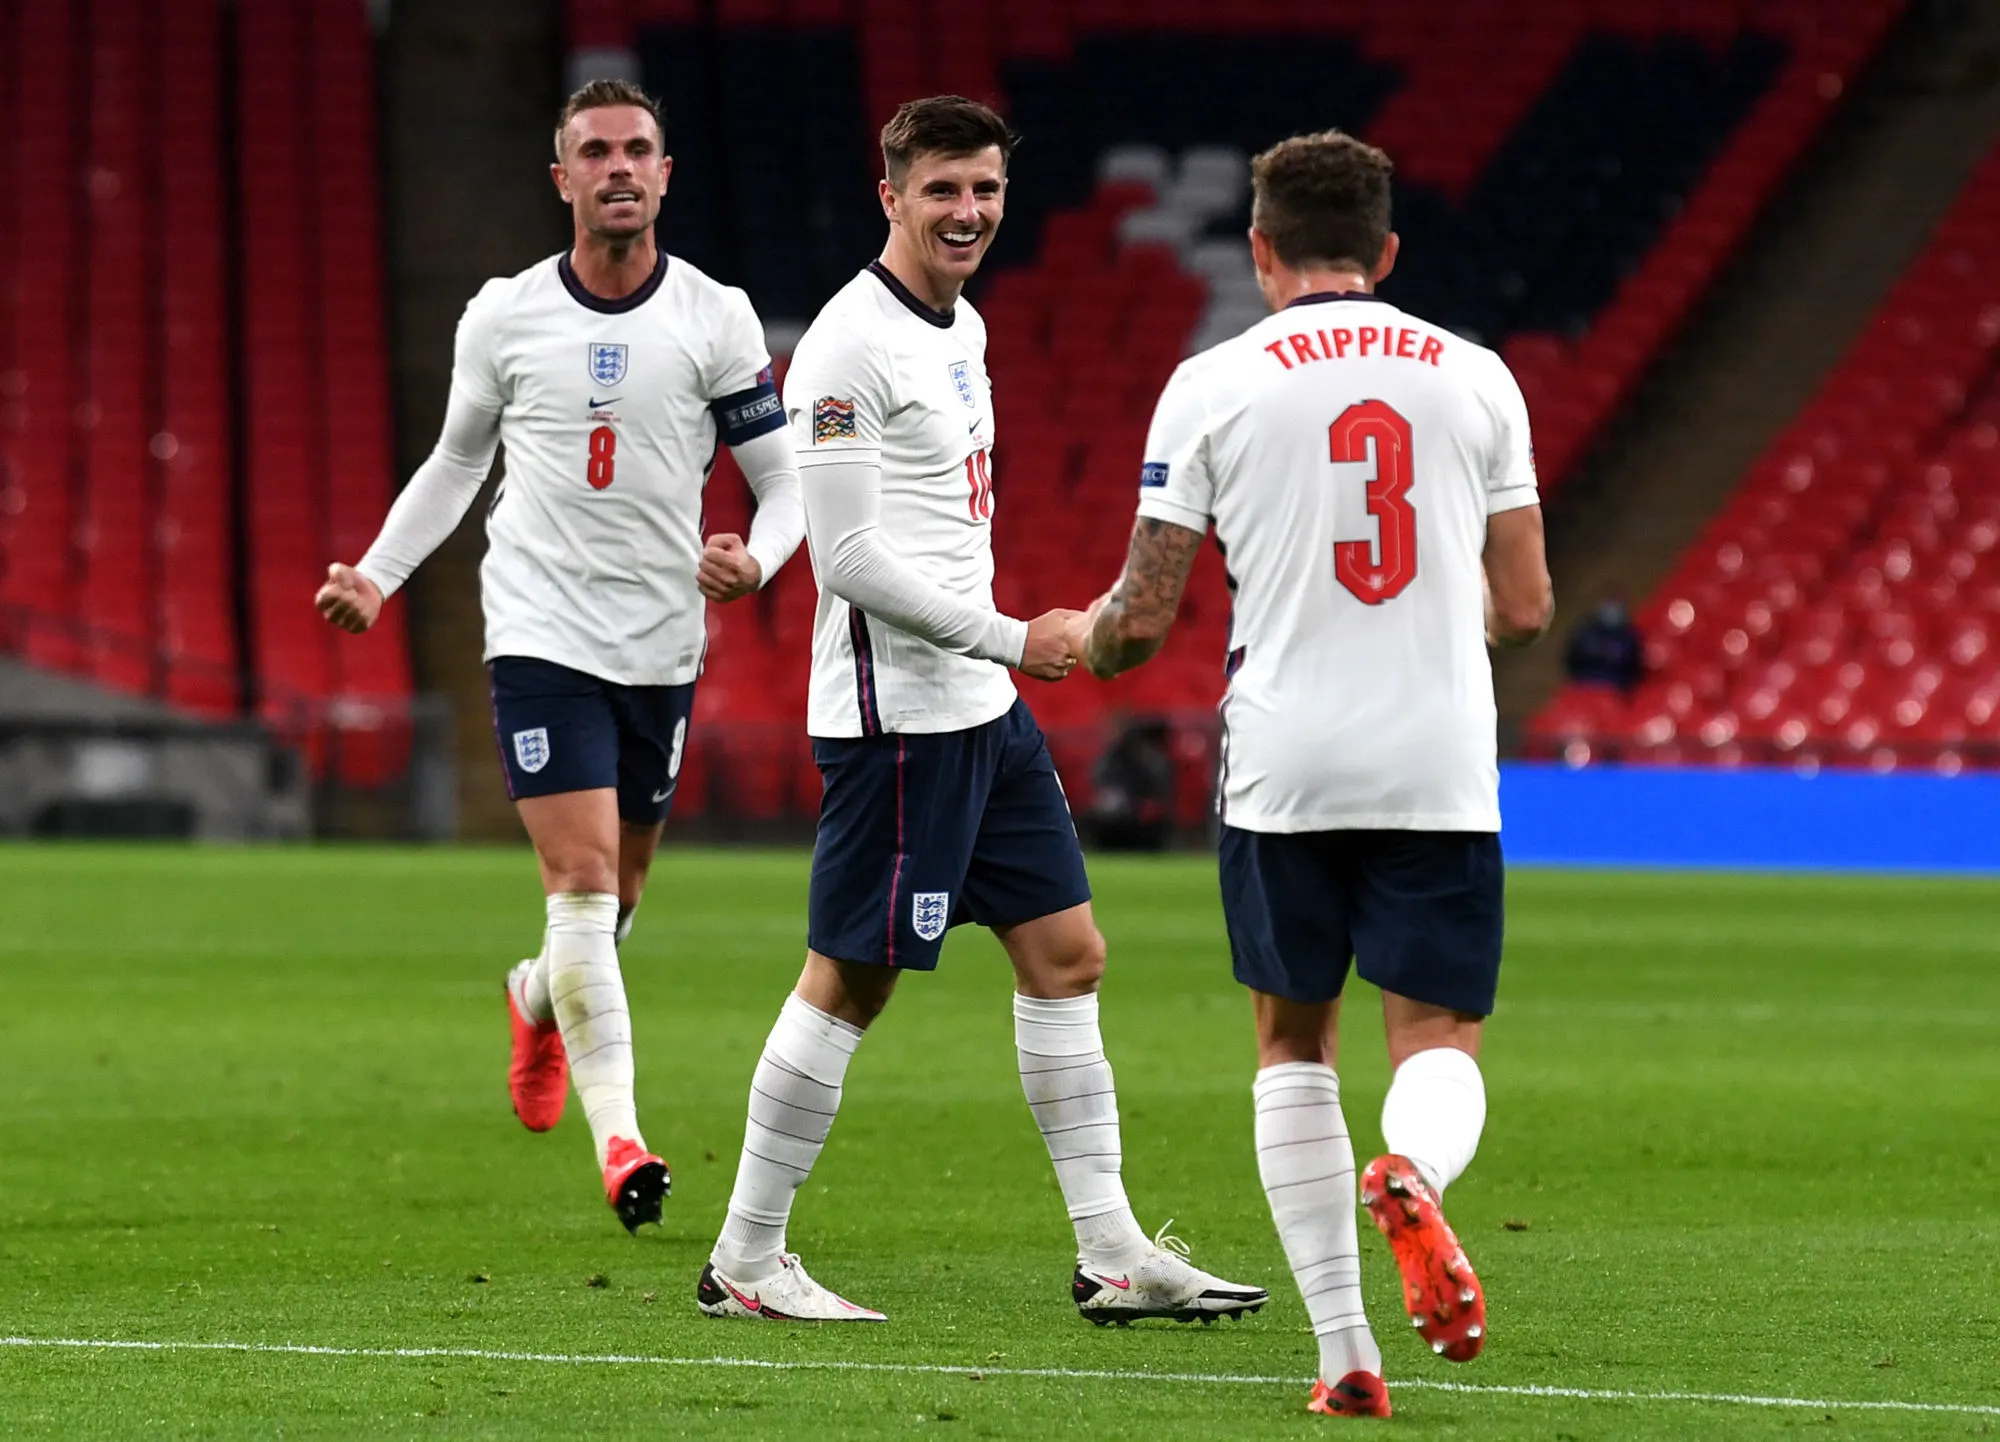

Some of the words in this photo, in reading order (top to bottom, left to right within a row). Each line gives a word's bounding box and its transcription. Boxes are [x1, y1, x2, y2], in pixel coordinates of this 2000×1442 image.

[1264, 326, 1445, 371] TRIPPIER
[587, 425, 616, 490] 8
[1329, 399, 1417, 605] 3
[668, 716, 686, 779] 8
